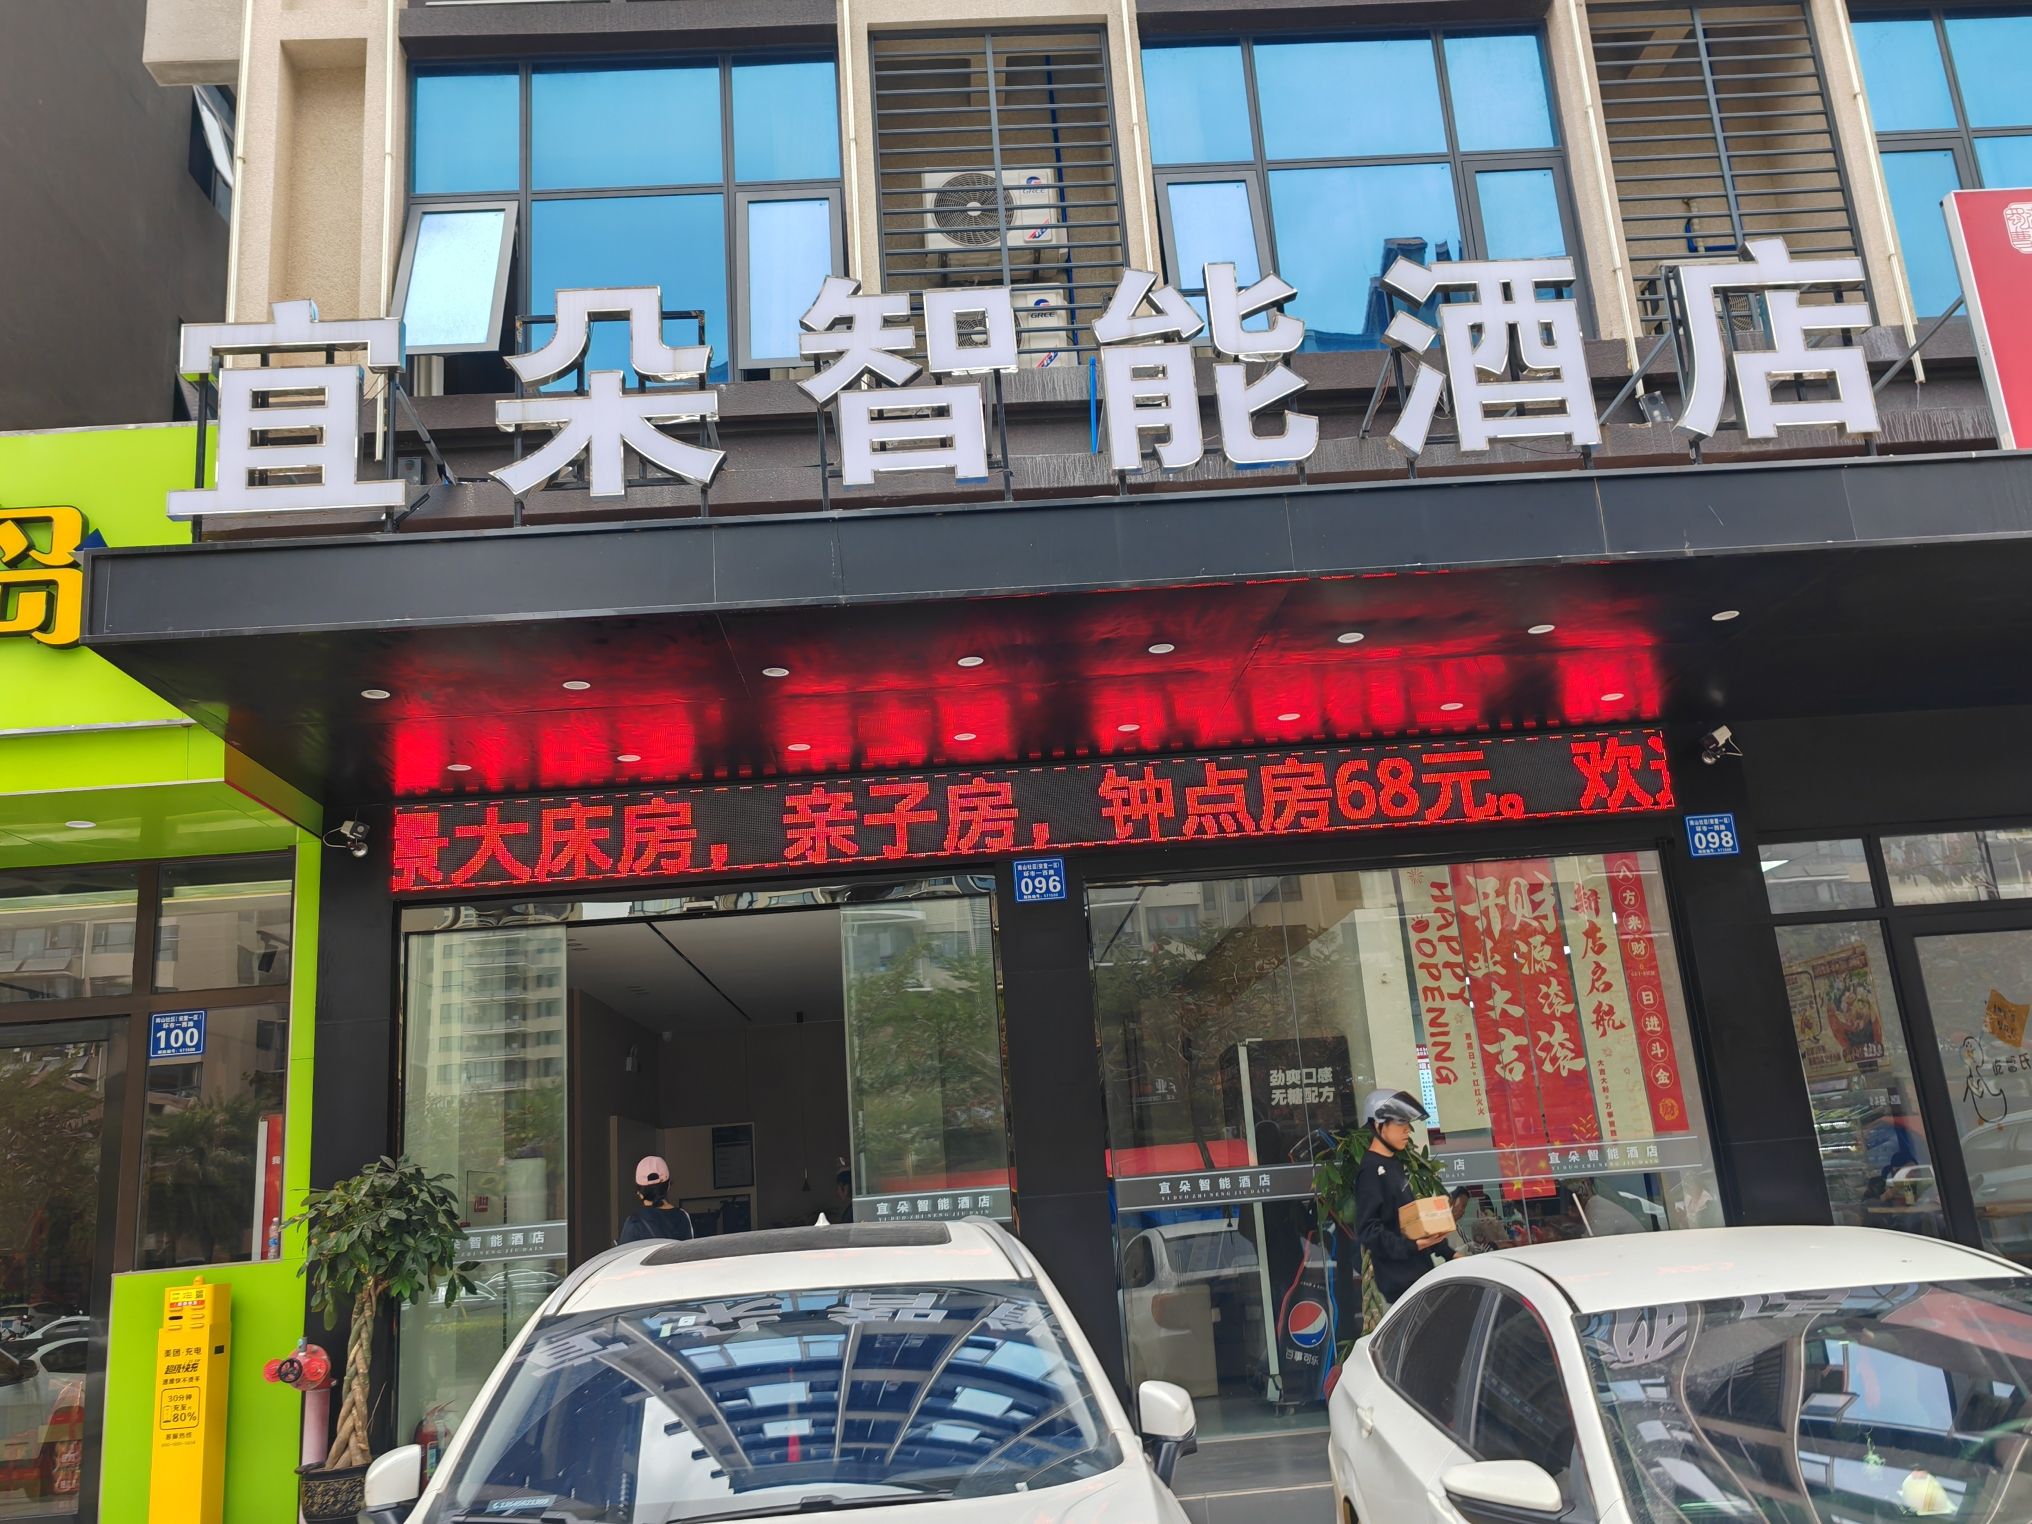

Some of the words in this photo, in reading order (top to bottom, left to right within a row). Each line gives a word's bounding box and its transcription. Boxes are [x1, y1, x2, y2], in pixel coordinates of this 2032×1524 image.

[1030, 311, 1056, 319] GREE
[166, 237, 1880, 521] 宜朵智能酒店
[1694, 831, 1734, 849] 098
[1020, 875, 1062, 895] 096
[1618, 864, 1647, 956] 八方来财
[1429, 881, 1471, 1008] HAPPY
[1459, 874, 1529, 1083] 开业大吉
[1507, 870, 1587, 1078] 财源滚滚
[1414, 937, 1459, 1086] OPENING
[156, 1027, 199, 1049] 100
[1641, 990, 1671, 1085] 日进斗金
[1269, 1066, 1333, 1086] 劲爽口感
[1271, 1086, 1336, 1106] 无糖配方
[1547, 1144, 1659, 1165] 宜朵智能酒店
[1158, 1173, 1271, 1195] 宜朵智能酒店
[876, 1195, 990, 1216] 宜朵智能酒店
[1285, 1347, 1320, 1367] 百事可乐
[163, 1362, 200, 1375] 超级快充
[167, 1393, 193, 1403] 30分钟
[172, 1411, 197, 1423] 80%
